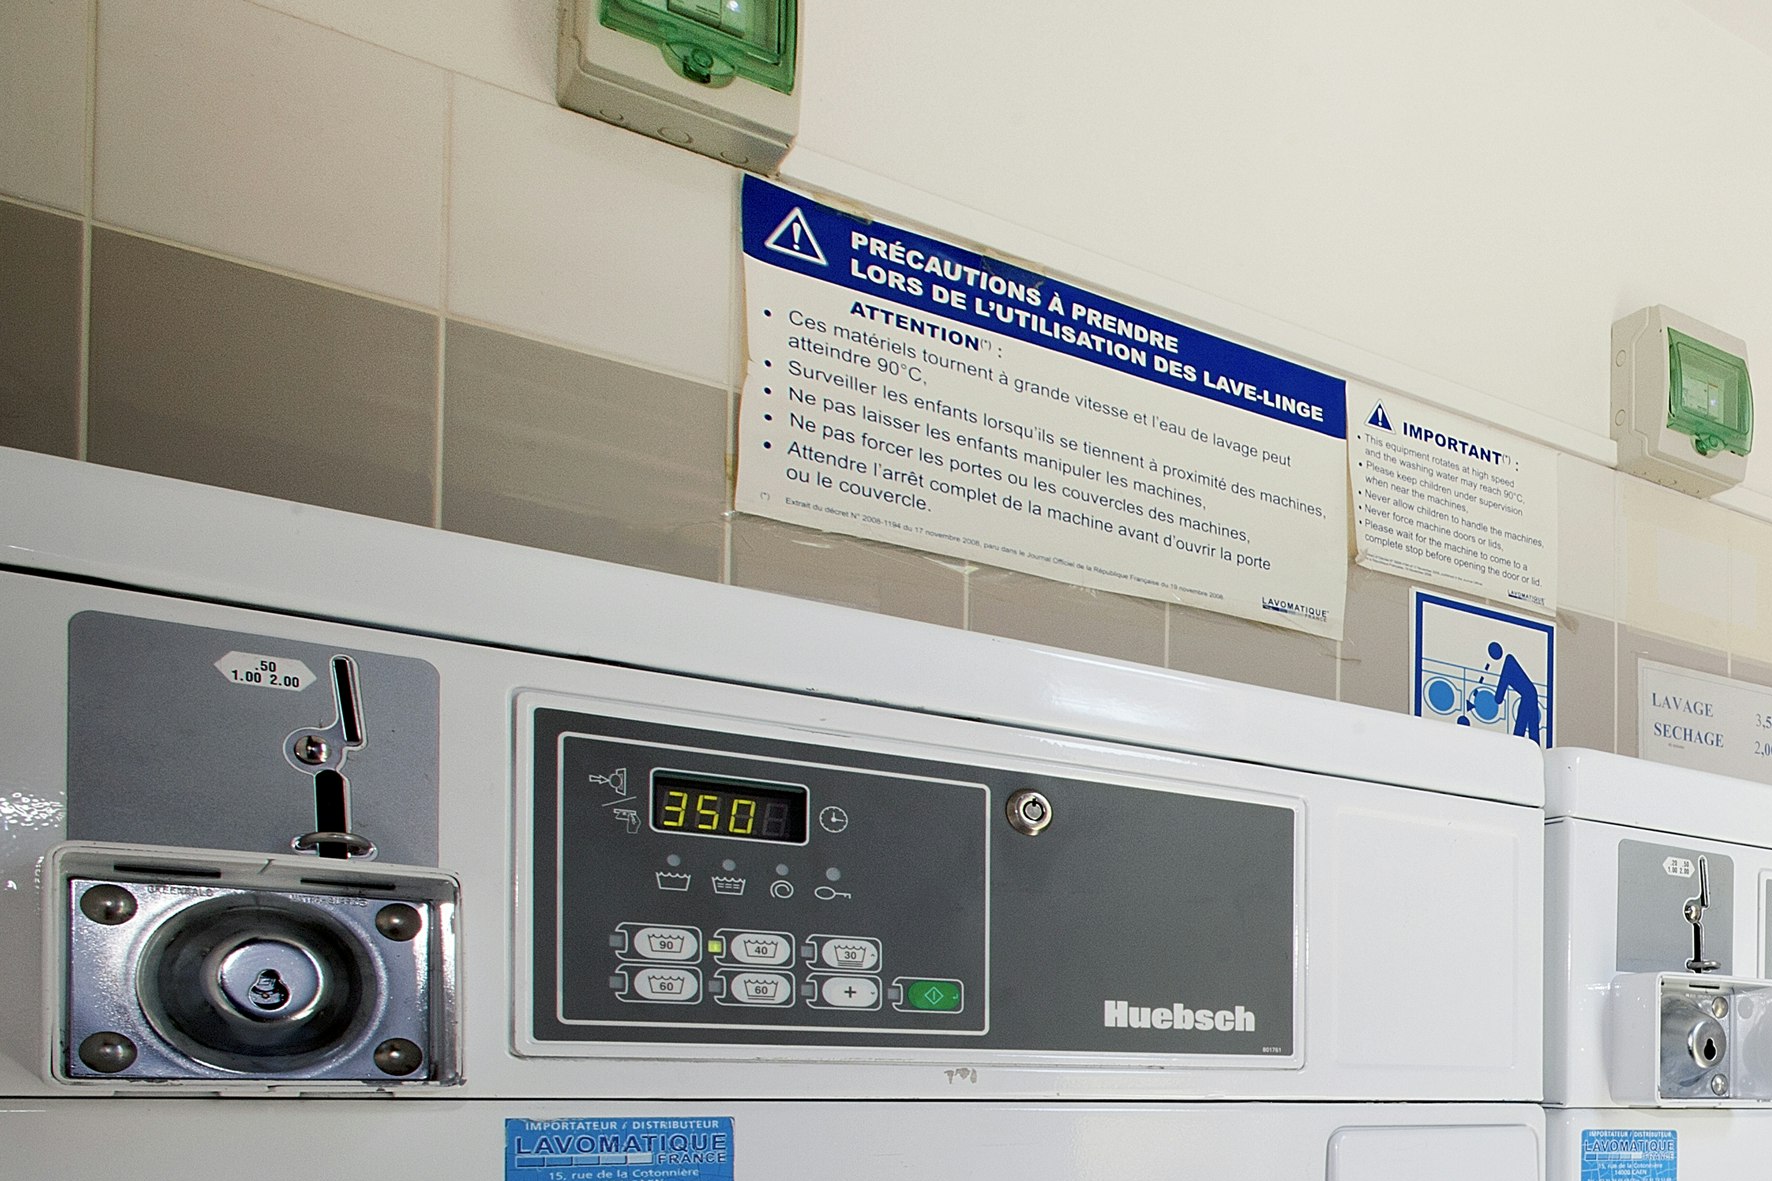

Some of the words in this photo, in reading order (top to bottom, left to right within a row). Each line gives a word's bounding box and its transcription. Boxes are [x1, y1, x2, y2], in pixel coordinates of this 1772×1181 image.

[851, 230, 1041, 306] PRÉCAUTIONS
[1047, 291, 1064, 316] À
[1071, 302, 1178, 354] PRENDRE
[850, 257, 923, 296] LORS
[931, 283, 966, 310] DE
[974, 296, 1146, 367] L'UTILISATION
[1153, 354, 1197, 382] DES
[1203, 369, 1323, 422] LAVE-LINGE
[787, 335, 871, 368] atteindre
[788, 309, 827, 333] Ces
[833, 325, 916, 359] matériels
[922, 348, 993, 381] tournent
[998, 370, 1008, 386] à
[1013, 377, 1070, 403] grande
[1074, 394, 1128, 420] vitesse
[1132, 412, 1147, 426] et
[1151, 414, 1186, 436] l'eau
[1190, 427, 1208, 443] de
[1212, 432, 1258, 458] lavage
[1261, 449, 1291, 467] peut
[1364, 432, 1383, 447] This
[1384, 441, 1430, 462] equipment
[1431, 455, 1460, 471] rotates
[1461, 465, 1470, 474] at
[1471, 466, 1489, 480] high
[1490, 474, 1514, 488] speed
[1262, 596, 1327, 617] LAVOMATIQUE
[231, 669, 262, 683] 1.00
[269, 674, 300, 688] 2.00
[1652, 692, 1714, 718] LAVAGE
[1654, 722, 1724, 748] SECHAGE
[663, 790, 757, 834] 350
[659, 940, 674, 950] 90
[754, 946, 768, 955] 40
[844, 951, 857, 960] 30
[659, 981, 674, 991] 60
[754, 985, 768, 995] 60
[1104, 1000, 1256, 1031] Huebsch
[525, 1119, 617, 1131] IMPORTATEUR
[631, 1119, 718, 1129] DISTRIBUTEUR
[515, 1133, 728, 1154] LAVOMATIQUE
[1584, 1140, 1675, 1152] LAVOMATIQUE
[657, 1152, 727, 1164] FRANCE
[571, 1171, 593, 1179] rue
[595, 1169, 613, 1179] de
[616, 1168, 628, 1179] la
[631, 1167, 699, 1178] Cotonnière
